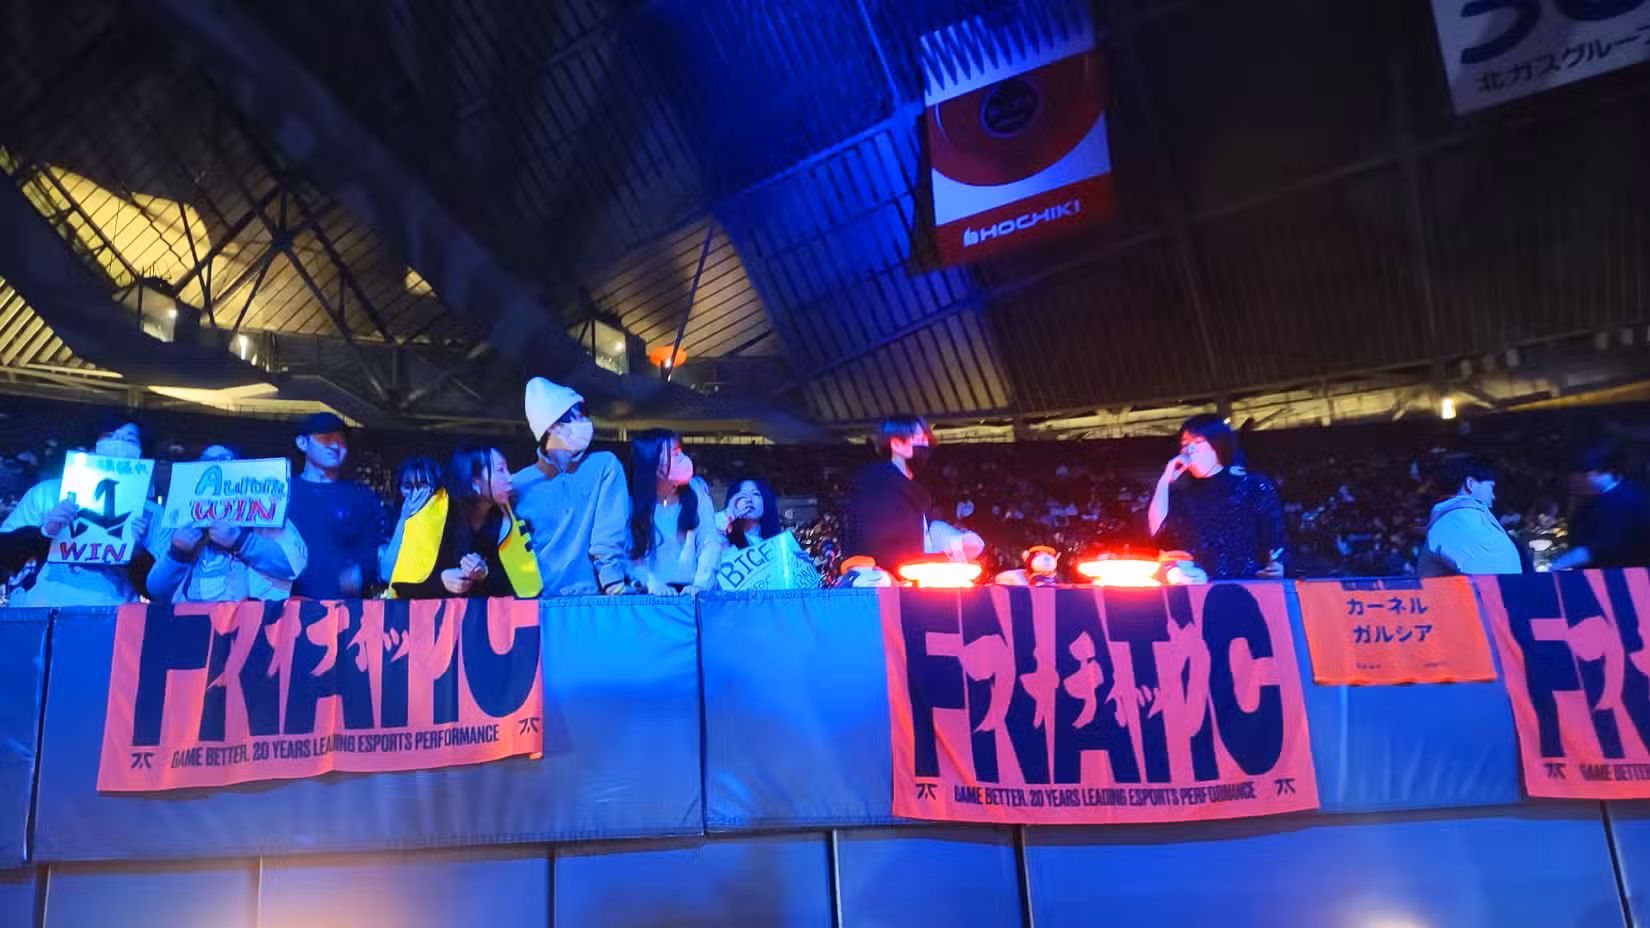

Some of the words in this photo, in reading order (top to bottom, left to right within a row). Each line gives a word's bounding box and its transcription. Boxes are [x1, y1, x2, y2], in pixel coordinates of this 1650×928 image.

[980, 199, 1080, 242] HOCHIKI
[191, 499, 276, 521] WIN
[60, 541, 127, 561] WIN
[1346, 596, 1429, 615] カーネル
[1353, 624, 1433, 643] ガルシア
[900, 583, 1284, 784] FNATIC
[171, 747, 203, 768] GAME
[205, 744, 250, 767] BETTER.
[252, 741, 269, 761] 20
[272, 739, 311, 759] YEARS
[358, 731, 412, 752] ESPORTS
[415, 724, 499, 750] PERFORMANCE
[954, 785, 983, 804] GAME
[1029, 789, 1044, 807] 20
[1046, 788, 1081, 807] YEARS
[1082, 787, 1126, 807] LEADING
[1129, 787, 1180, 806] ESPORTS
[1180, 781, 1256, 806] PERFORMANCE
